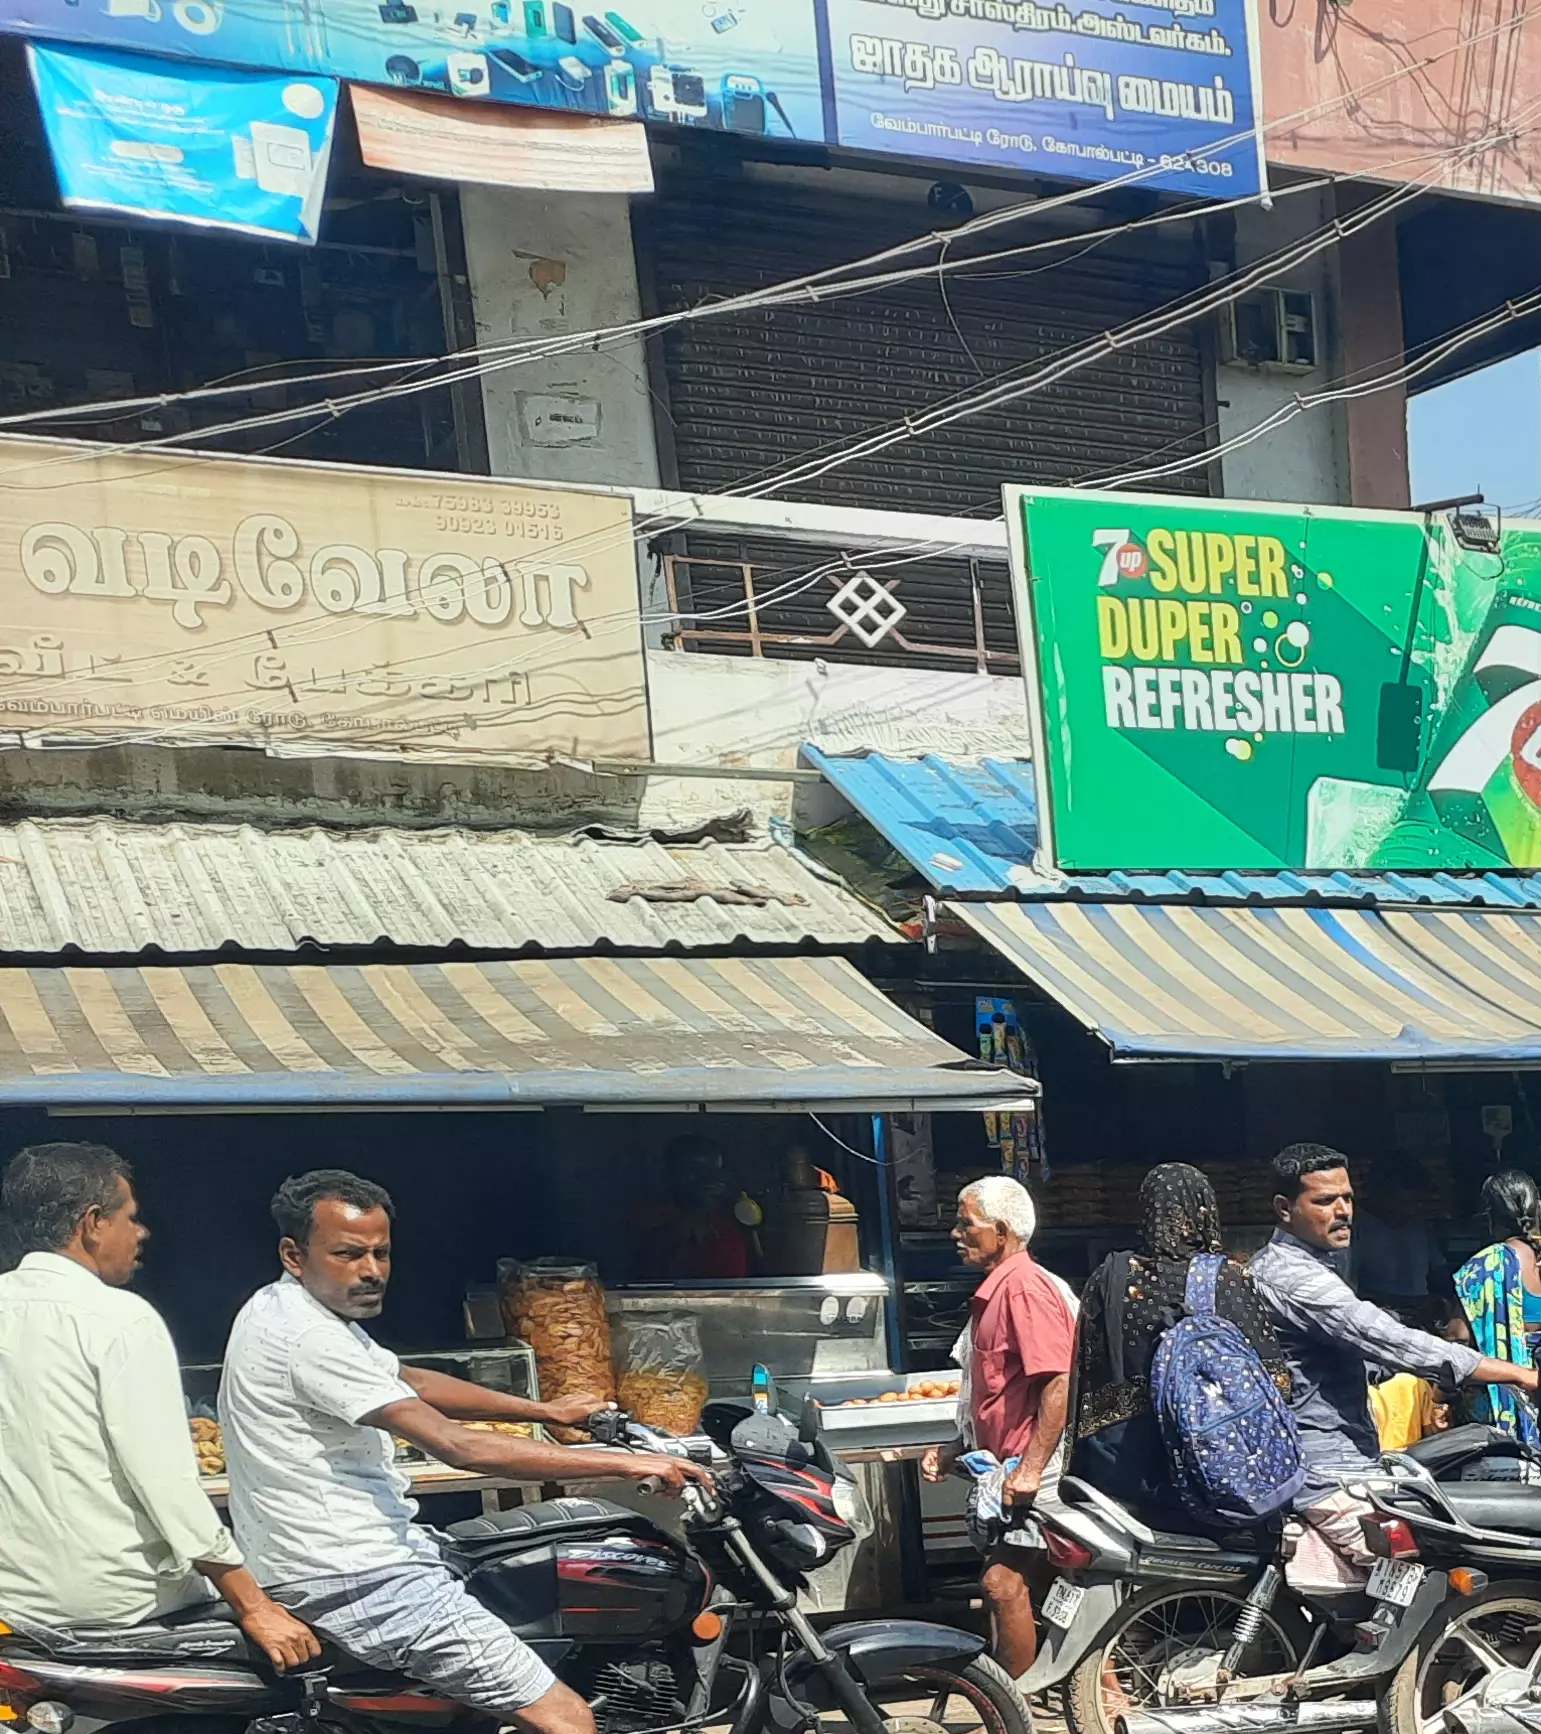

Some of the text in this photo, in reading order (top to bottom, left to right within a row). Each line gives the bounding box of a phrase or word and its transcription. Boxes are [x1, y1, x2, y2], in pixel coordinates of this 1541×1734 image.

[850, 33, 962, 93] ஜாதக
[1117, 75, 1235, 124] மையம்
[20, 513, 593, 630] வடிவேலா
[1147, 528, 1290, 599] SUPER
[1097, 596, 1245, 664] DUPER
[1102, 665, 1346, 734] REFRESHER
